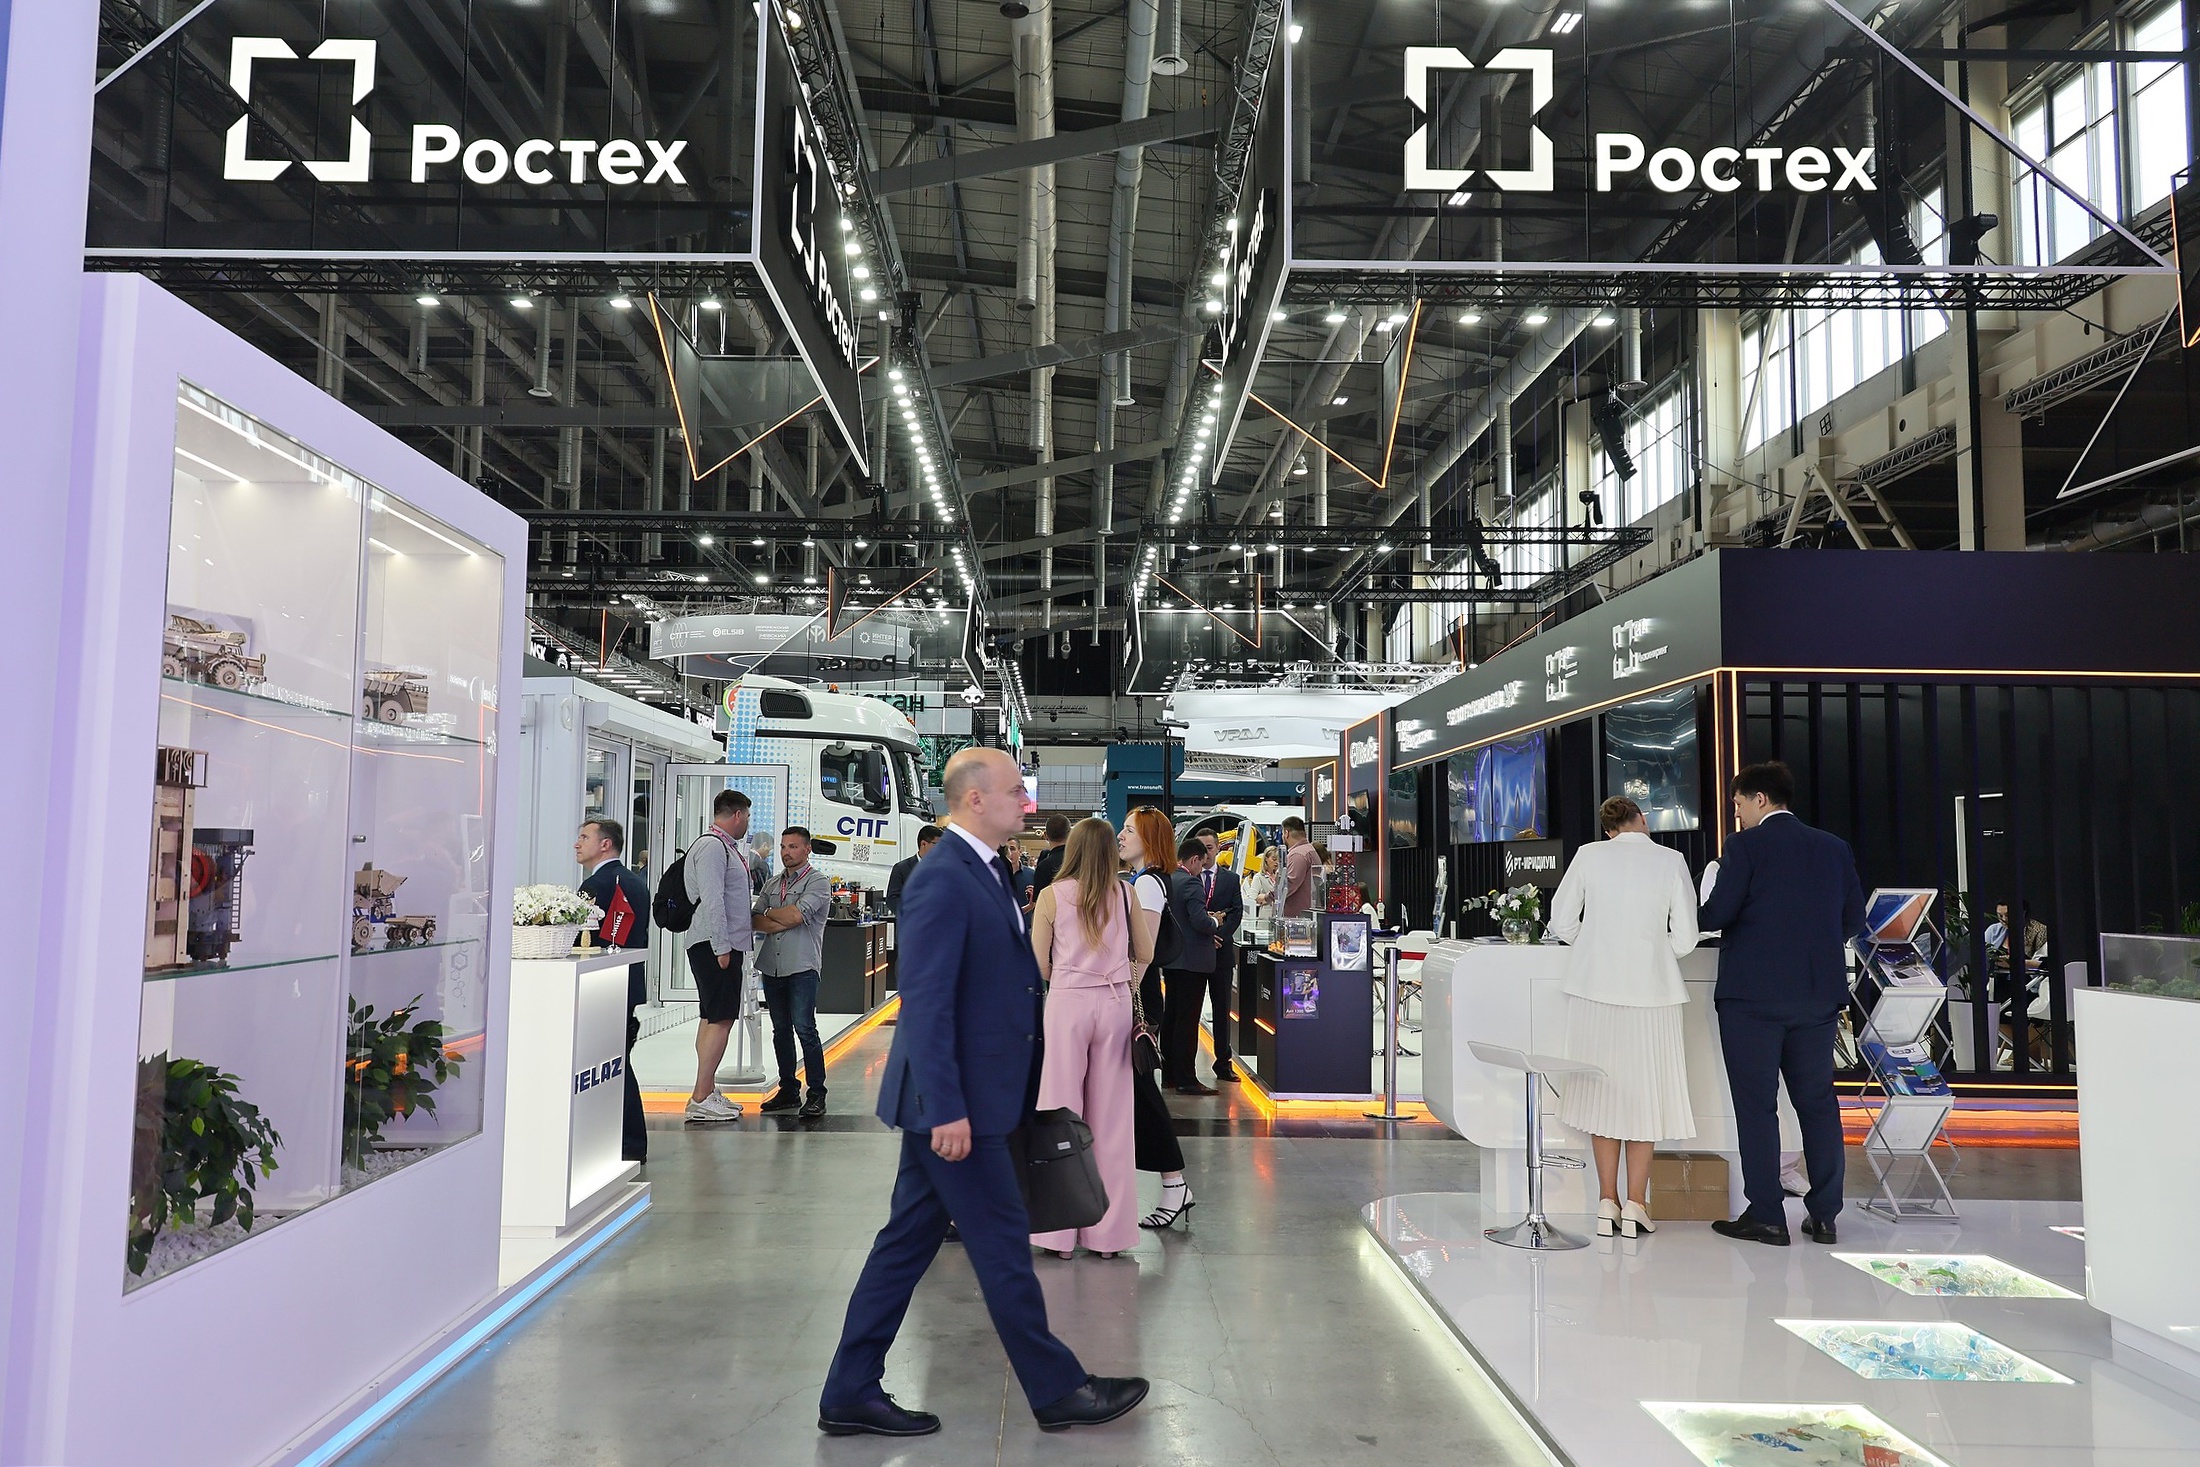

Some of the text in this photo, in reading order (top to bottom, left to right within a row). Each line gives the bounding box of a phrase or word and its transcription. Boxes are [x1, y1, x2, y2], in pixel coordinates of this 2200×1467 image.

[410, 123, 689, 185] Ростех
[1596, 132, 1878, 193] Ростех
[1238, 187, 1265, 319] Ростех
[818, 250, 854, 370] Ростех
[836, 816, 889, 839] СПГ
[1513, 855, 1557, 872] РТ-ИРИДИУМ
